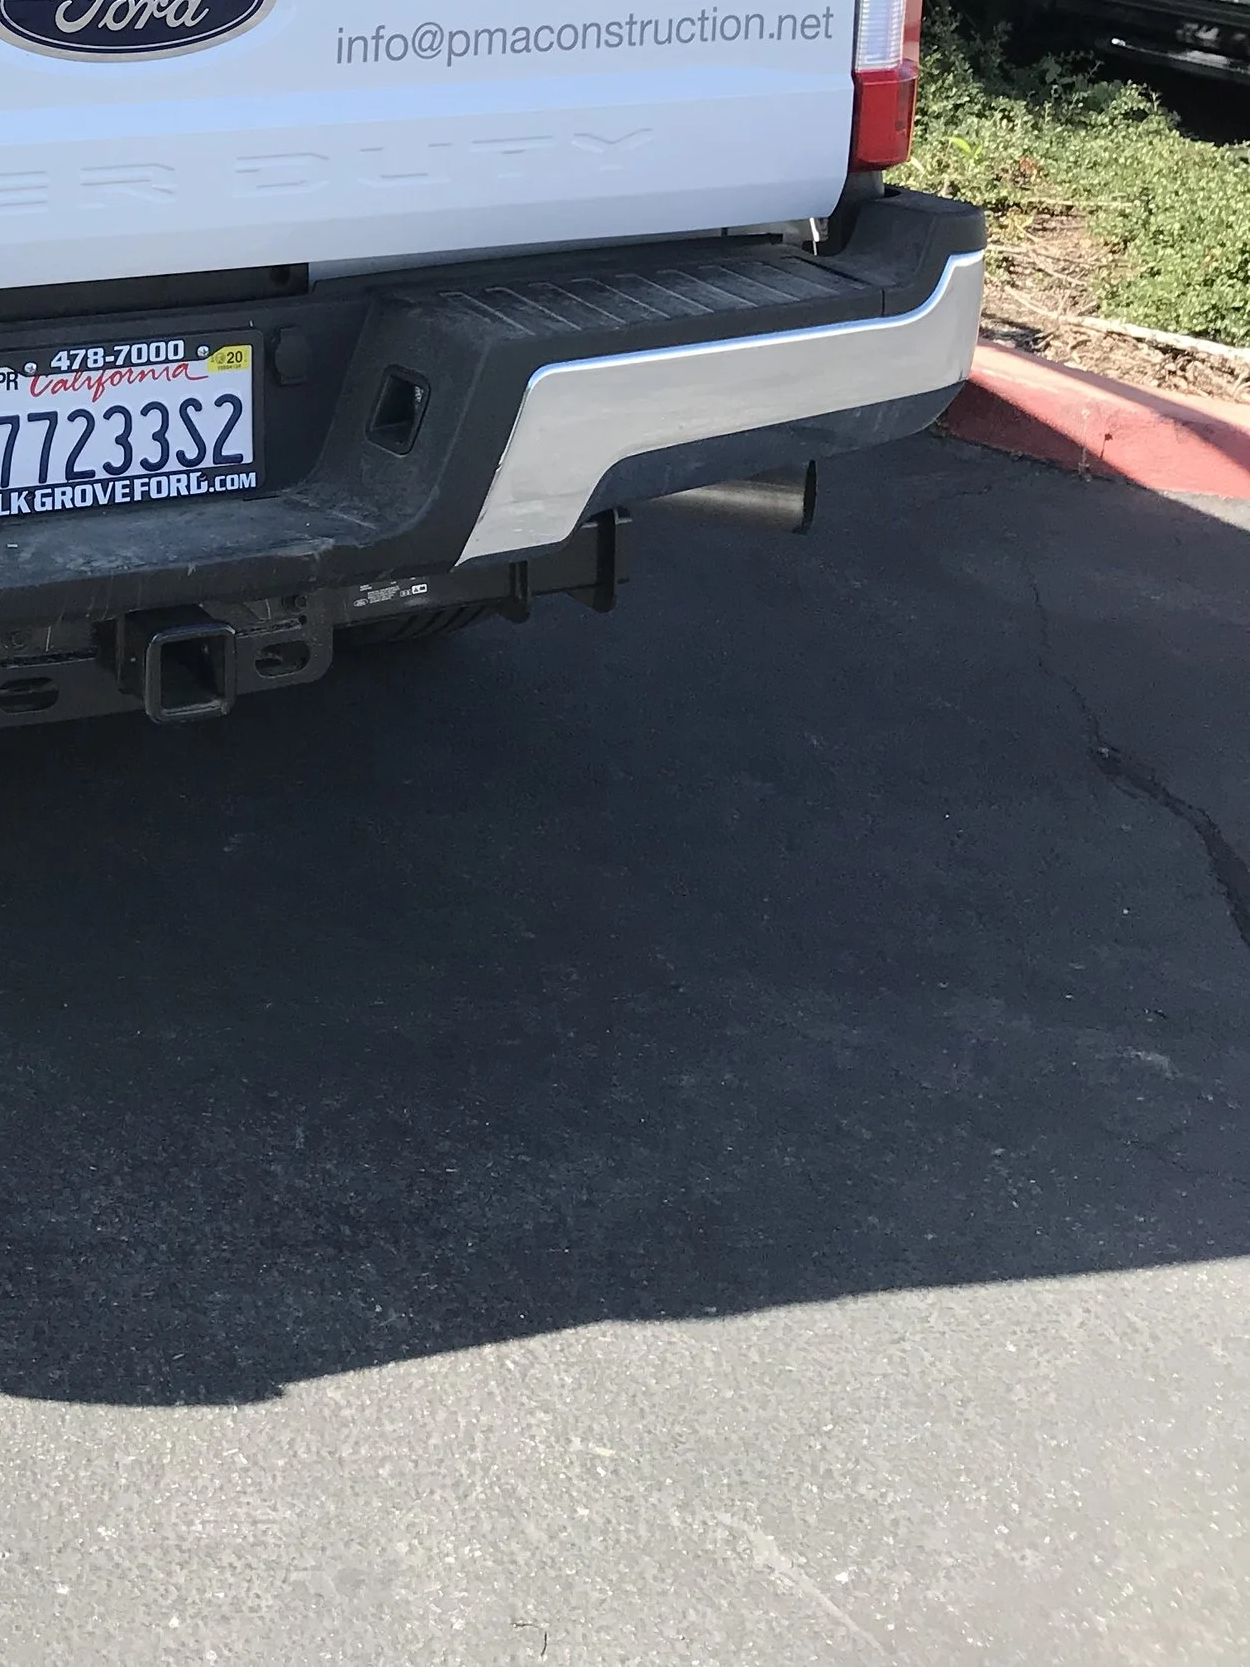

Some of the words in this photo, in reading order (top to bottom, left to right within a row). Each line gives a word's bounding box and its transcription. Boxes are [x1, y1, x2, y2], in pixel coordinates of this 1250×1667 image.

[336, 6, 835, 67] info@pmaconstruction.net
[232, 128, 654, 200] DUTY
[50, 339, 185, 371] 478-7000
[226, 350, 243, 364] 20
[29, 362, 210, 403] California
